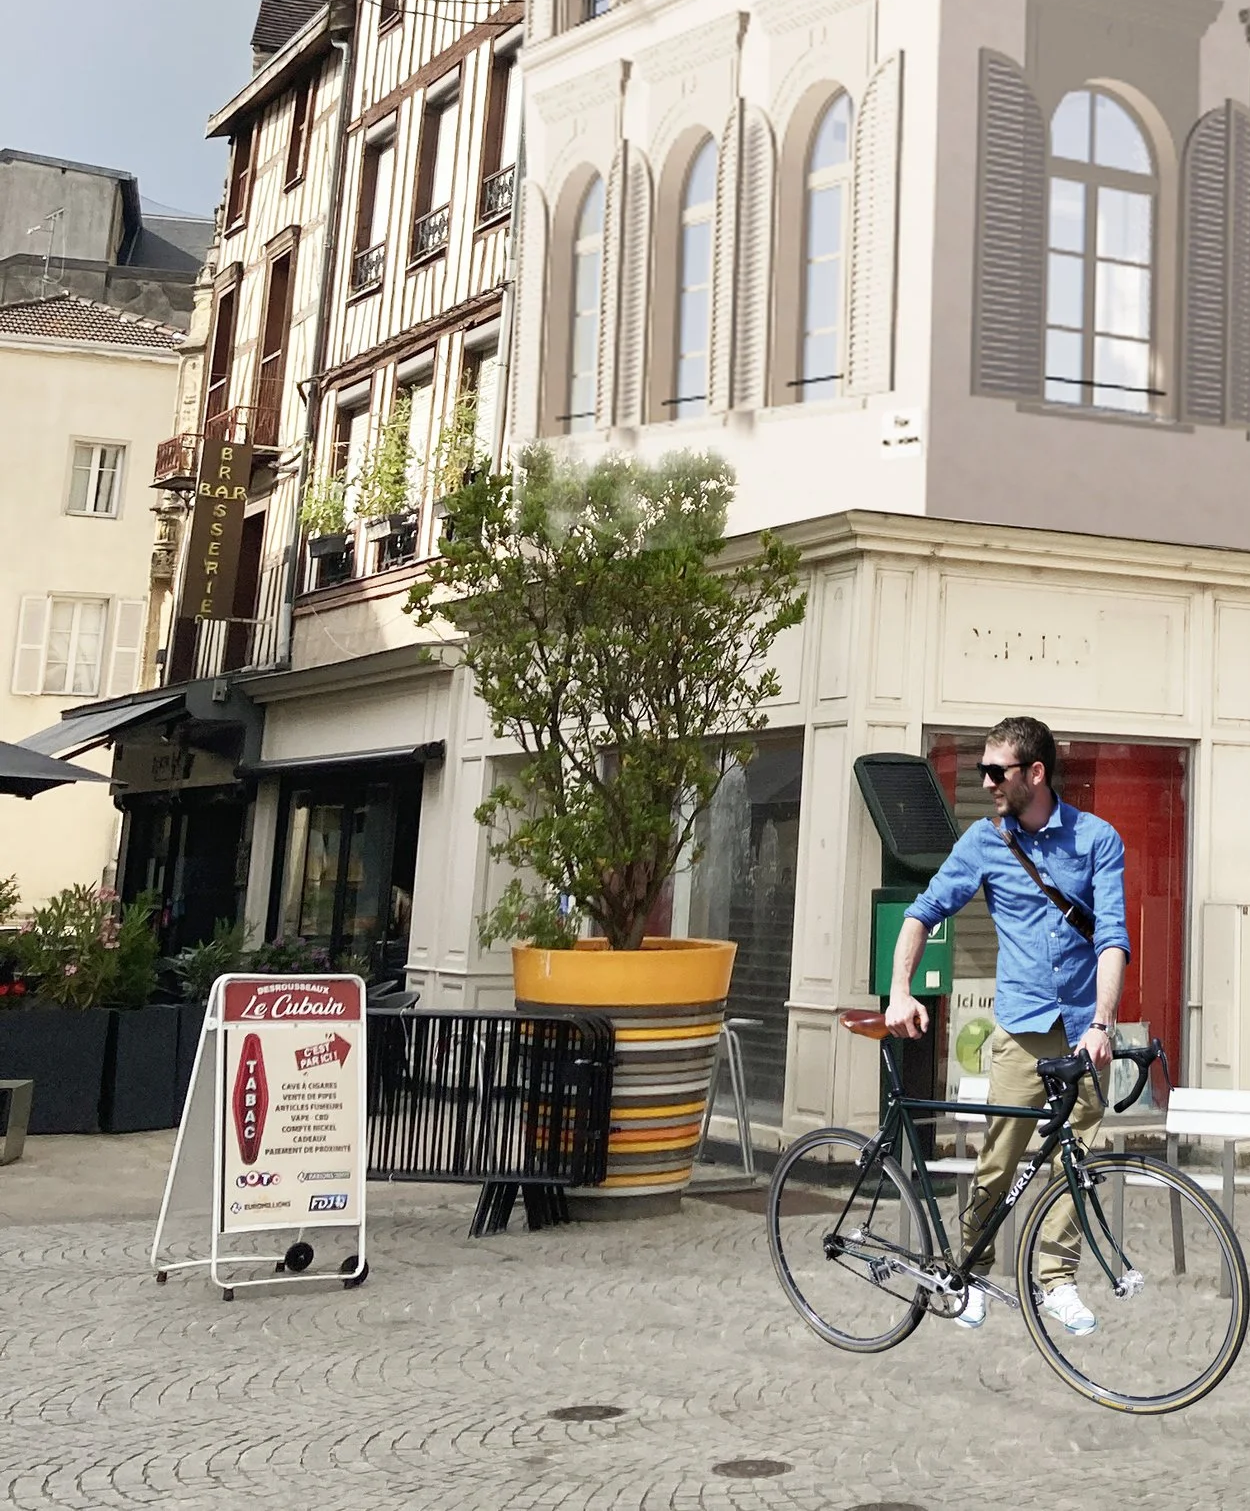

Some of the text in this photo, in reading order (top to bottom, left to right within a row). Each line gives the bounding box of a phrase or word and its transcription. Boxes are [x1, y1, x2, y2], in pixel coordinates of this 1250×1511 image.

[200, 446, 234, 614] BRASSERIE
[257, 983, 330, 995] DESROUSSEAUX
[240, 993, 347, 1020] Le Cubain
[957, 993, 974, 1009] Ici
[303, 1042, 331, 1058] C'EST
[300, 1056, 320, 1069] PAR
[320, 1053, 333, 1066] ICI
[281, 1082, 300, 1091] CAVE
[308, 1082, 338, 1090] CIGARES
[243, 1059, 258, 1140] TABAC
[282, 1092, 337, 1101] VENTE DE PIPES
[275, 1102, 343, 1112] ARTICLES FUMEURS
[290, 1114, 329, 1122] VAPE CBD
[281, 1124, 337, 1133] COMPTE NICKEL
[292, 1135, 327, 1143] CADEAUX
[264, 1147, 302, 1155] PAIEMENT
[303, 1146, 314, 1154] DE
[236, 1170, 281, 1188] LOTO
[1005, 1159, 1036, 1207] SURLY
